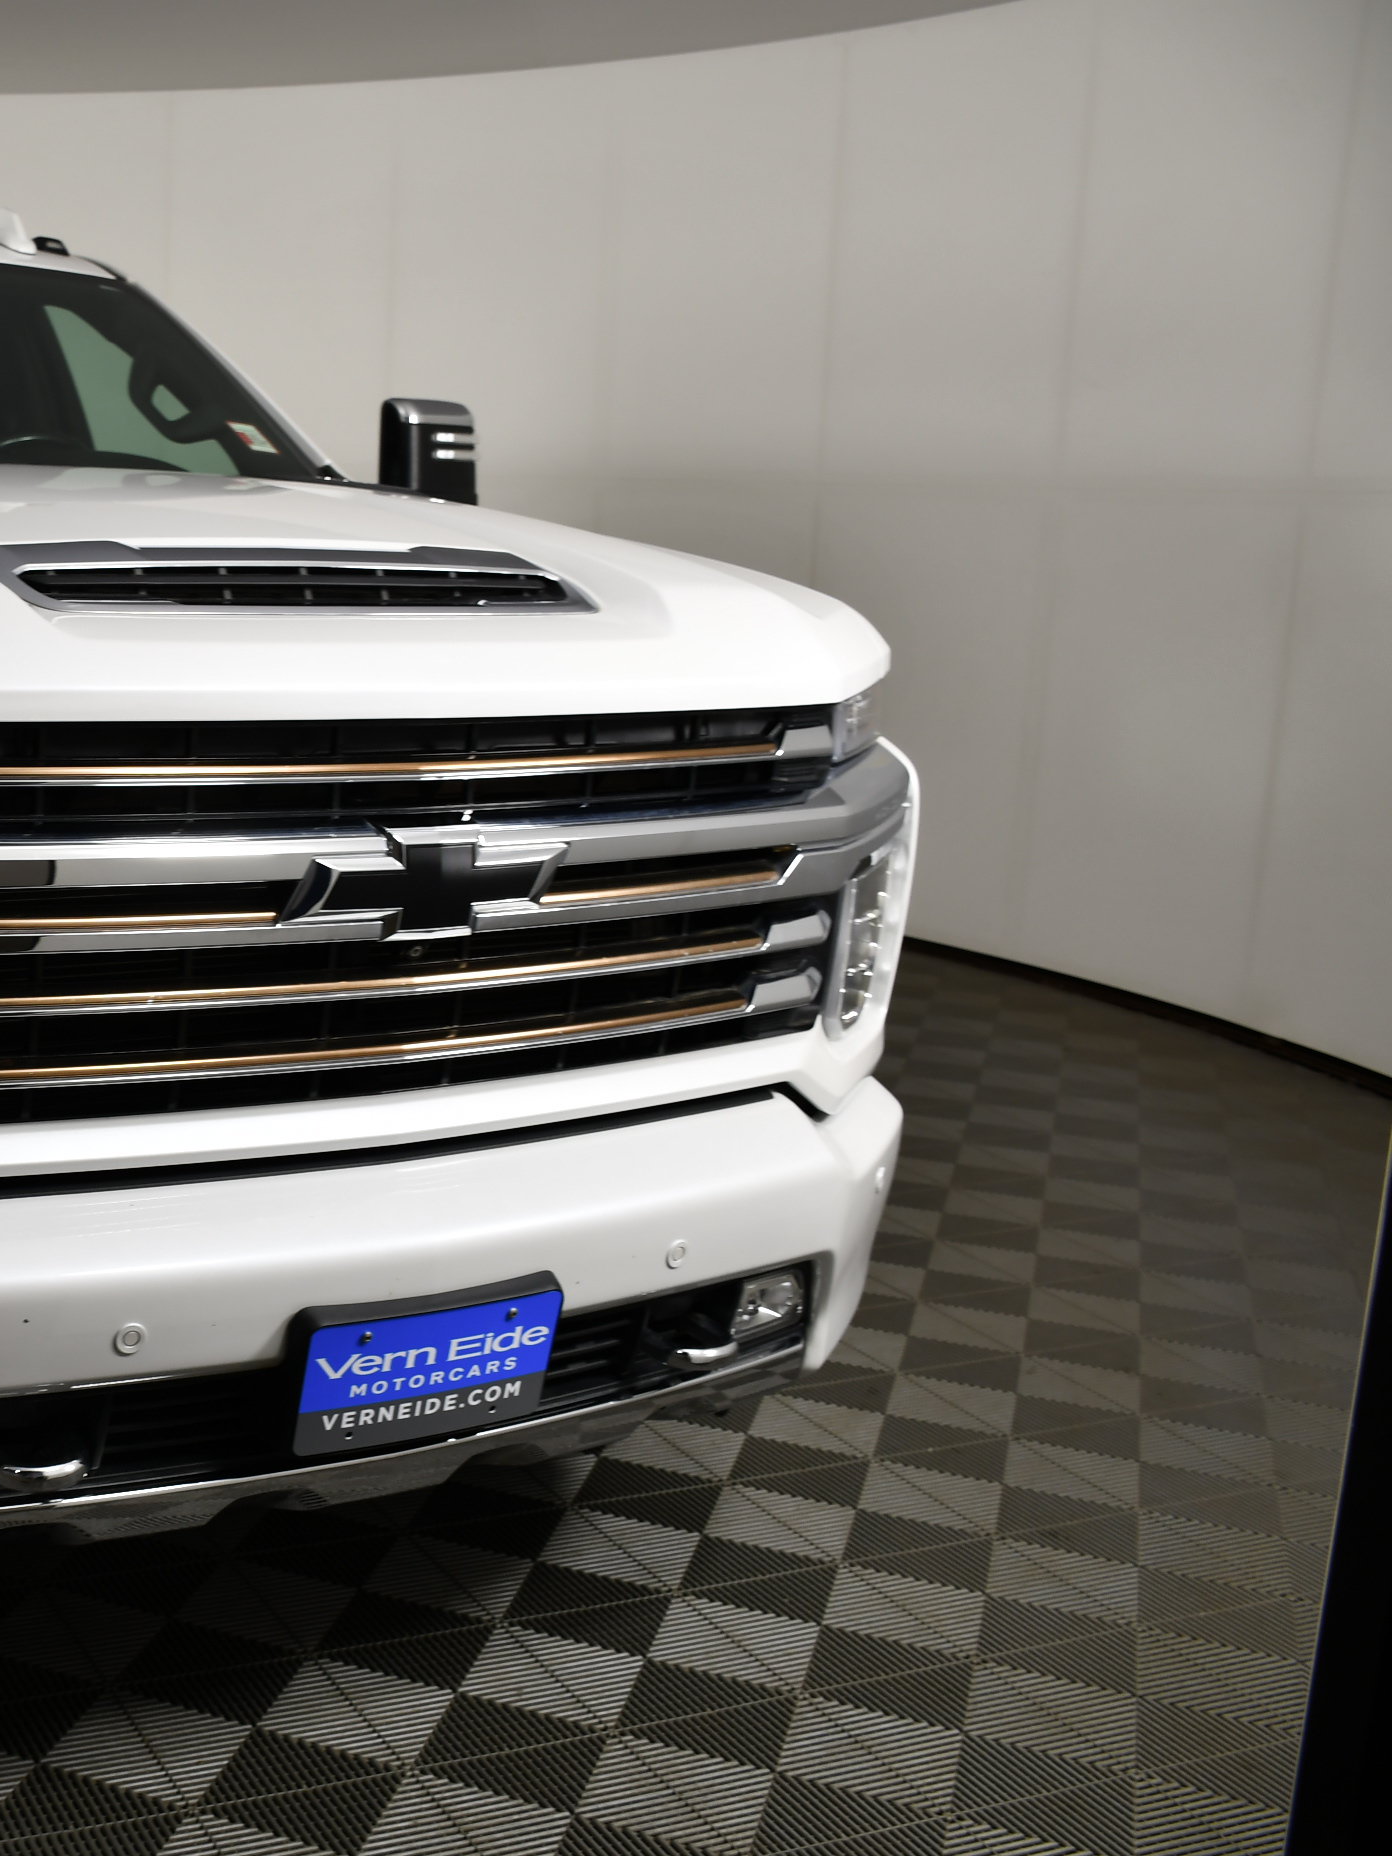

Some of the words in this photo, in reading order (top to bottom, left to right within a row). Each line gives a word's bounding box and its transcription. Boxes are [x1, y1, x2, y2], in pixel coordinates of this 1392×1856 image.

[316, 1345, 437, 1380] Vern
[446, 1325, 550, 1362] Eide
[349, 1356, 518, 1398] MOTORCARS
[321, 1380, 522, 1431] VERNEIDE.COM
